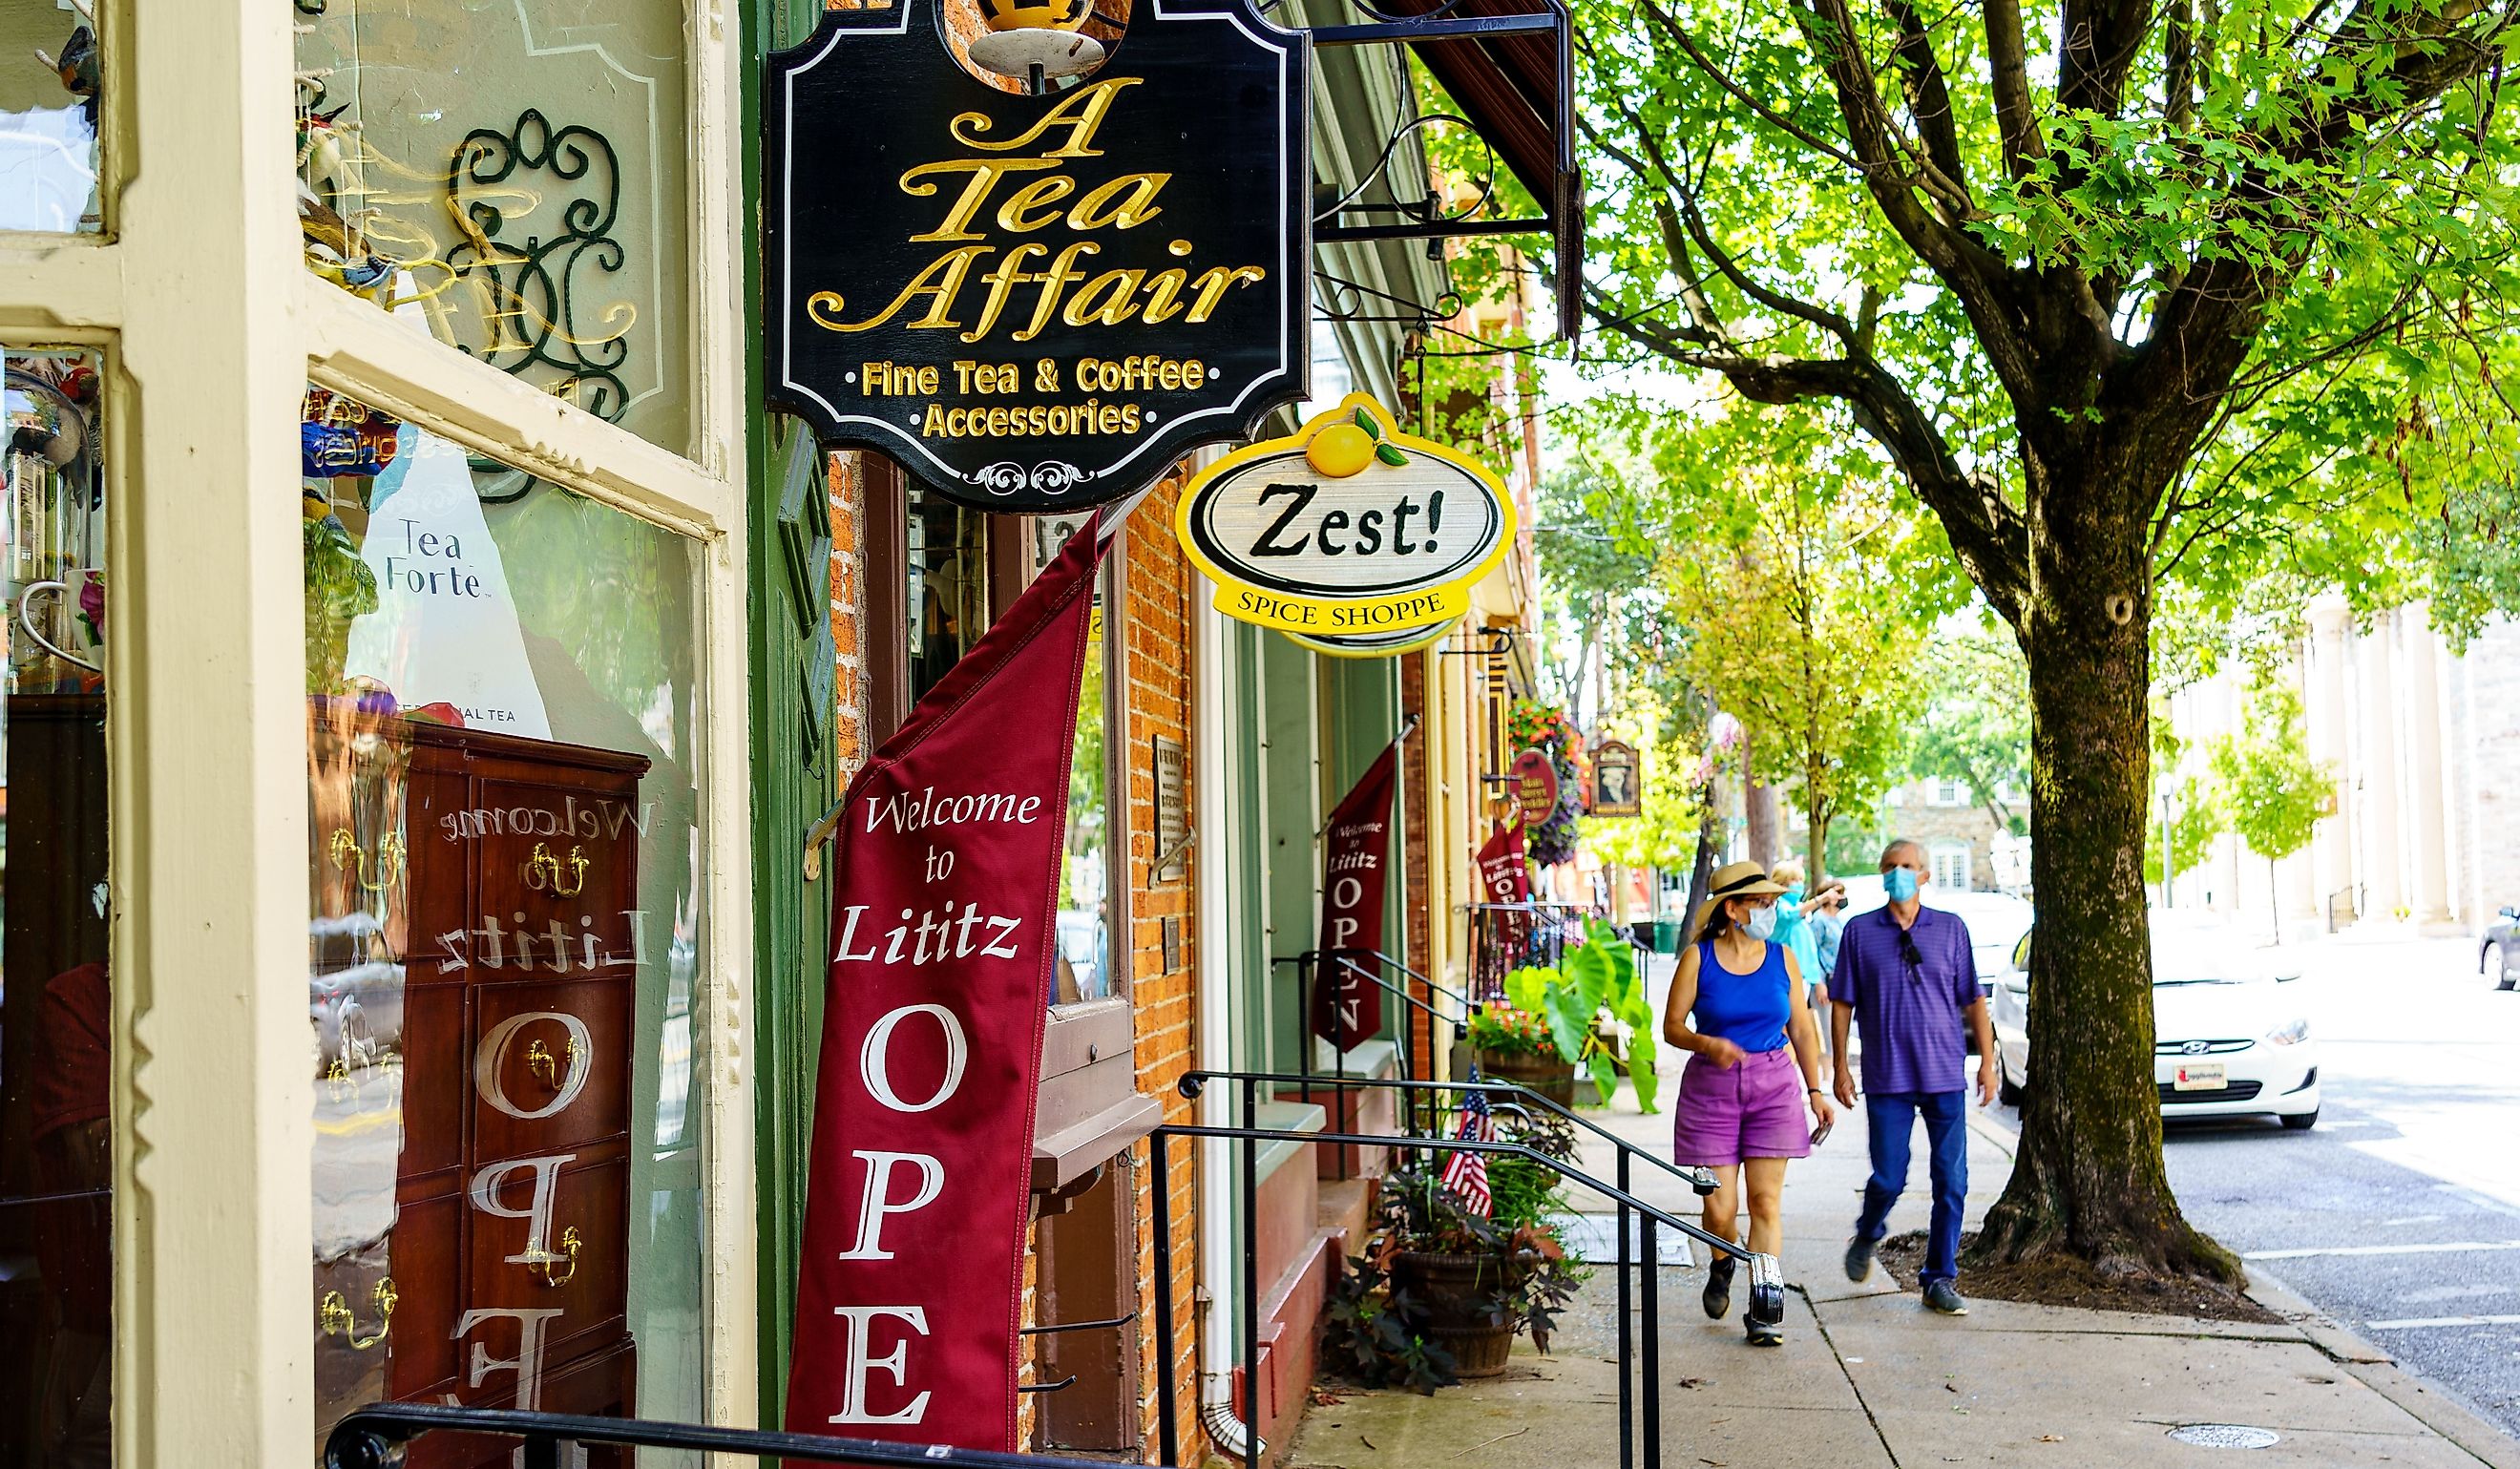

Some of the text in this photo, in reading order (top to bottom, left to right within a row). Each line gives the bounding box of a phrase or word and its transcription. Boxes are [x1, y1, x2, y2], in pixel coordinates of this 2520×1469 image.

[950, 77, 1144, 157] A
[899, 158, 1172, 242] Tea
[807, 239, 1266, 344] Affair
[862, 354, 1205, 396] Fine Tea & Coffee
[922, 399, 1141, 438] Accessories
[398, 518, 461, 560] Tea
[1250, 483, 1445, 557] Zest!
[1237, 591, 1446, 627] SPICE SHOPPE
[488, 709, 515, 723] TEA
[866, 786, 1041, 834] Welcome
[925, 845, 955, 884] to
[1329, 851, 1377, 873] Lititz
[833, 900, 1021, 966] Lititz
